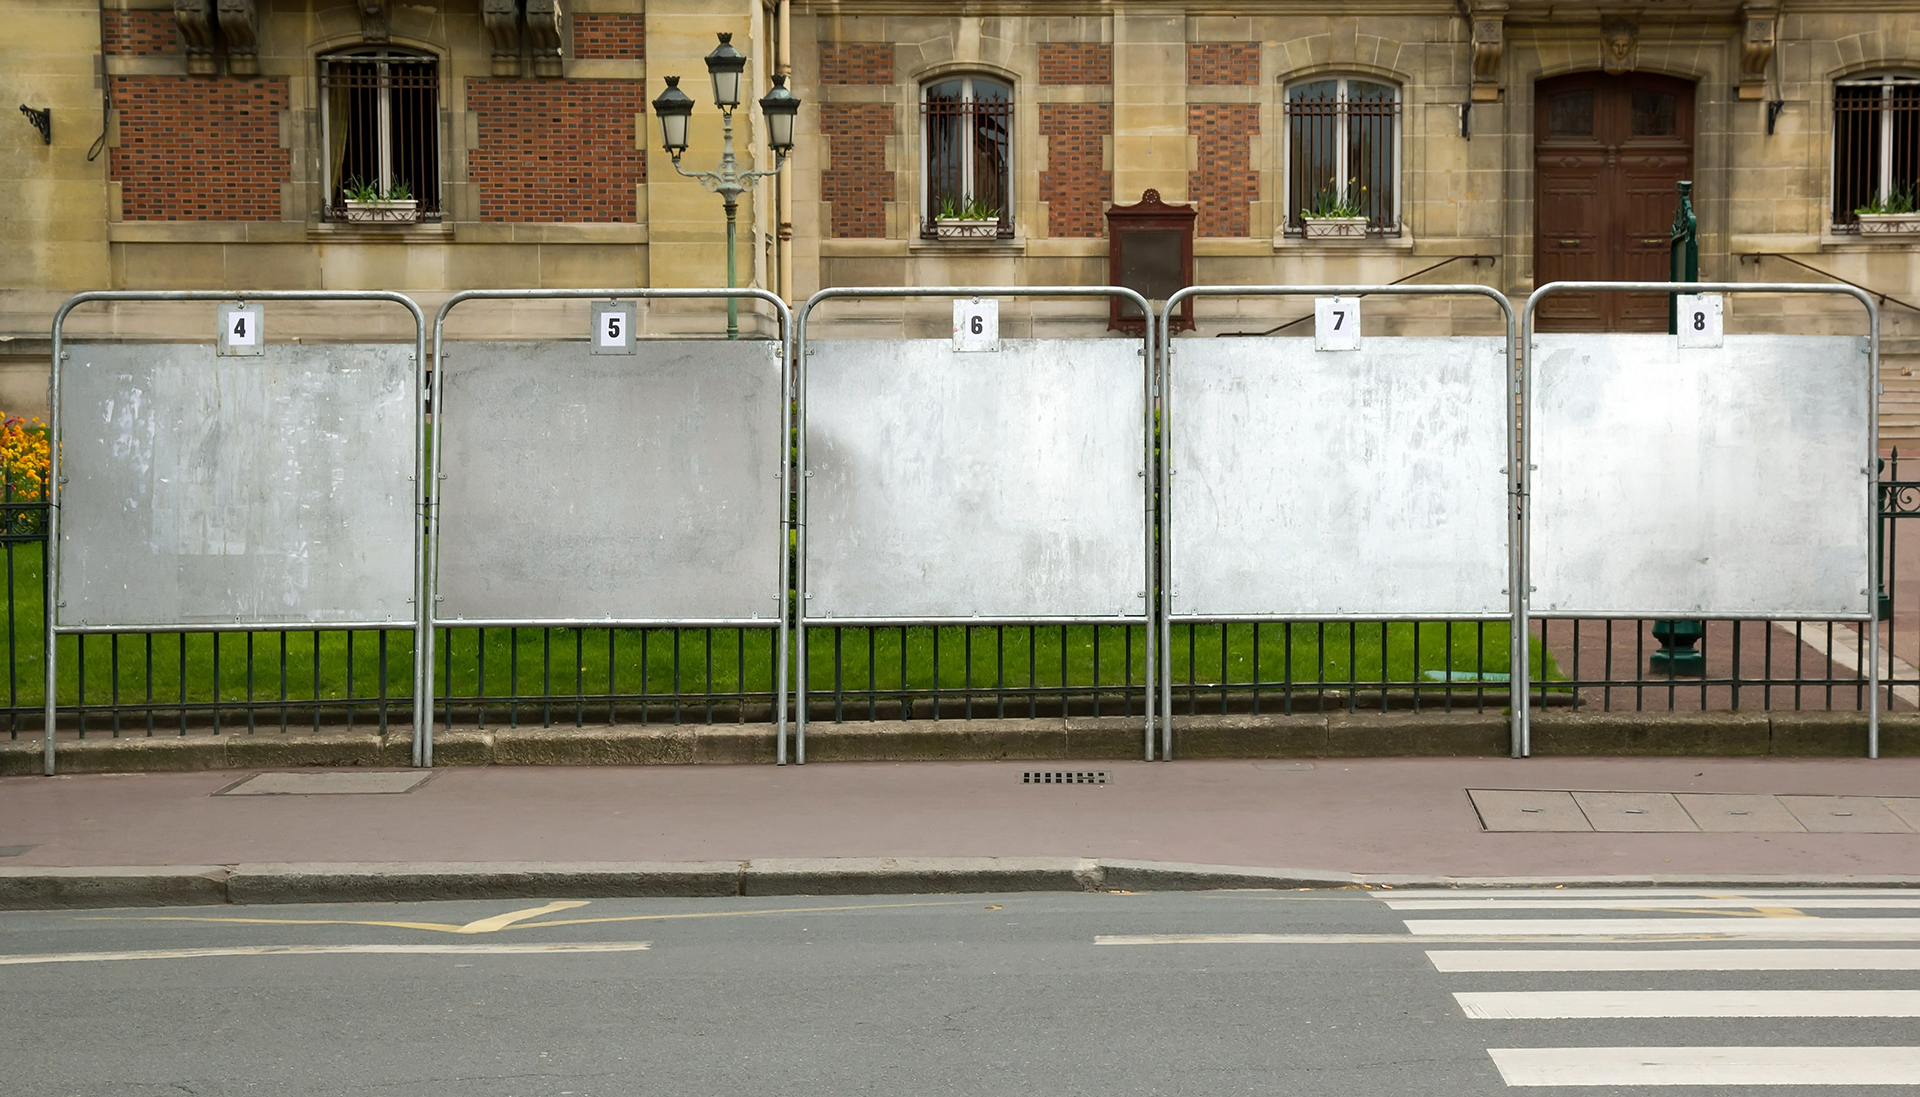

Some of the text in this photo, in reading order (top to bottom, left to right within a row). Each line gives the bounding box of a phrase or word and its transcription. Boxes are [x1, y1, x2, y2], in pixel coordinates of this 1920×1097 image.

[233, 317, 246, 338] 4
[608, 317, 620, 338] 5
[970, 315, 983, 335] 6
[1333, 311, 1345, 331] 7
[1693, 311, 1705, 331] 8
